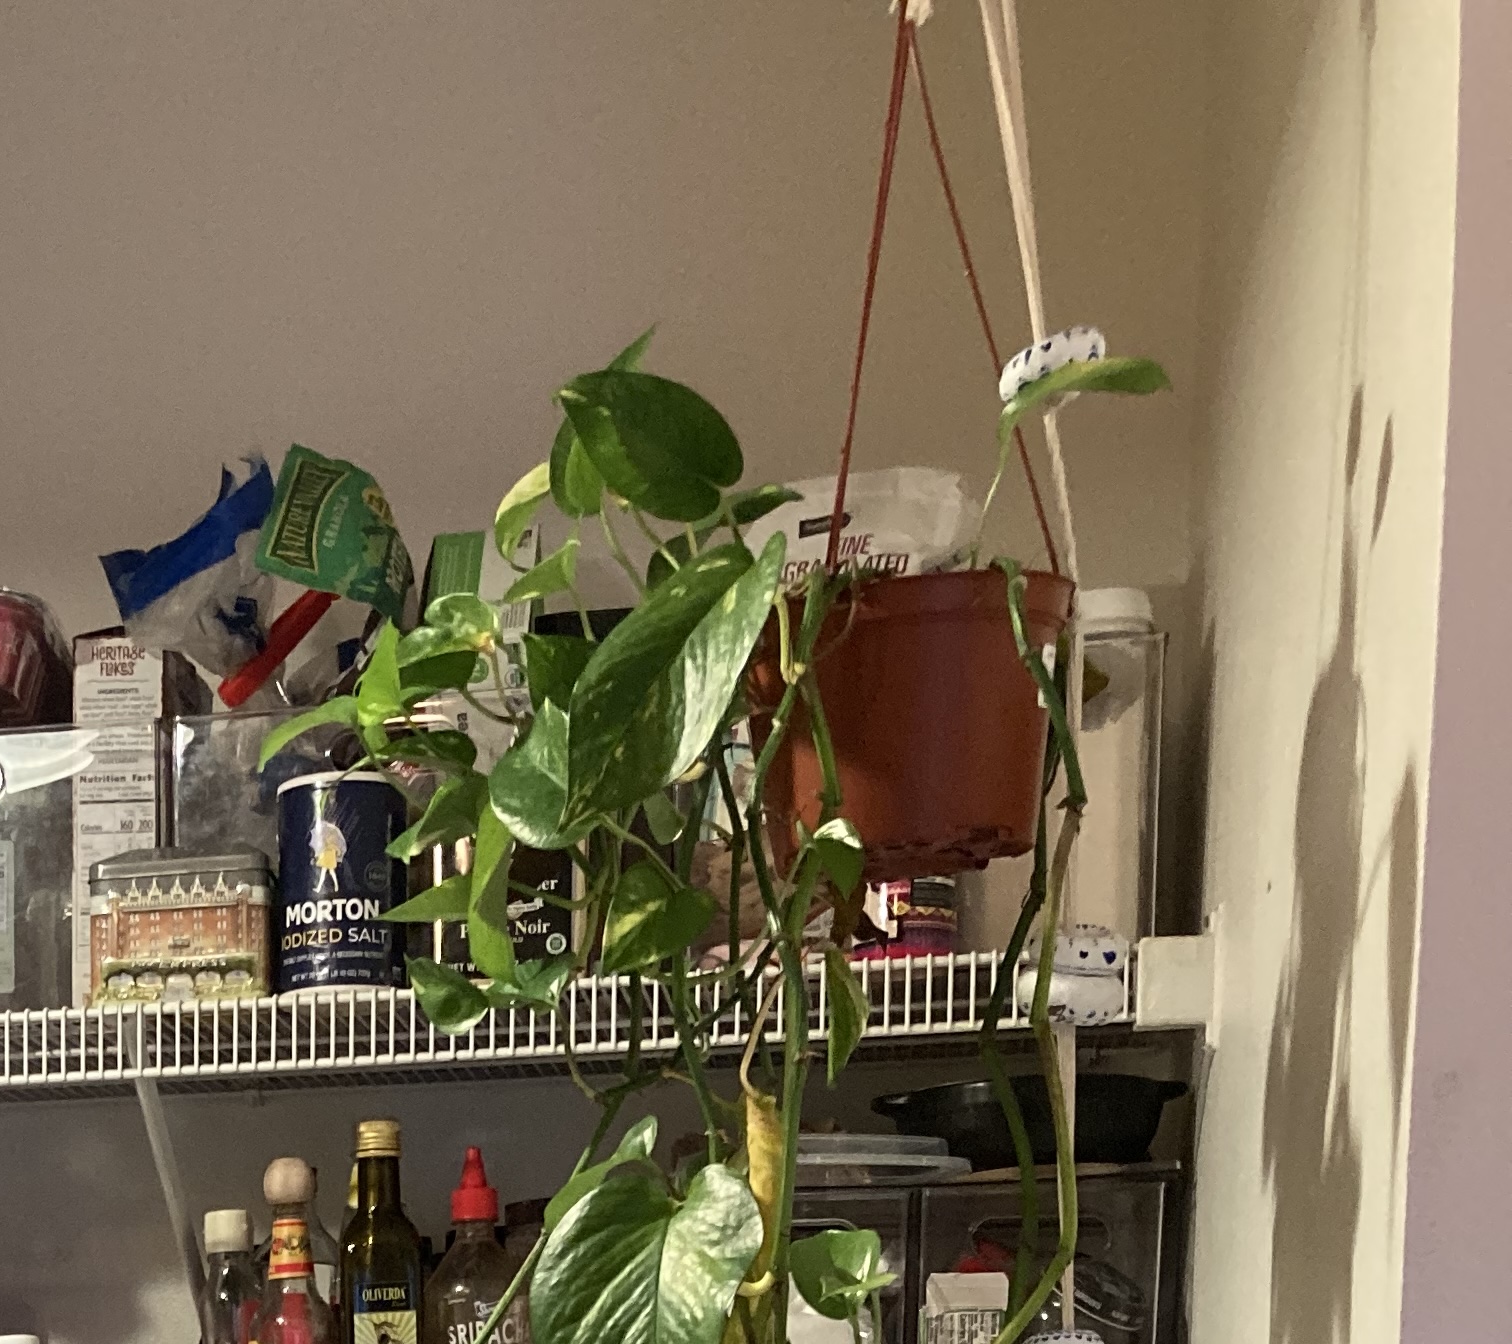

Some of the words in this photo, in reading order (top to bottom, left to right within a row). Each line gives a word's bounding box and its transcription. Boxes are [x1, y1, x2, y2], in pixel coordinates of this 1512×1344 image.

[91, 645, 146, 660] HERITAGE
[100, 662, 135, 677] FLAKES
[80, 775, 126, 783] Nutrition
[286, 899, 380, 928] MORTON
[514, 919, 551, 935] Noir
[281, 928, 342, 951] IODIZED
[348, 928, 388, 945] SALT
